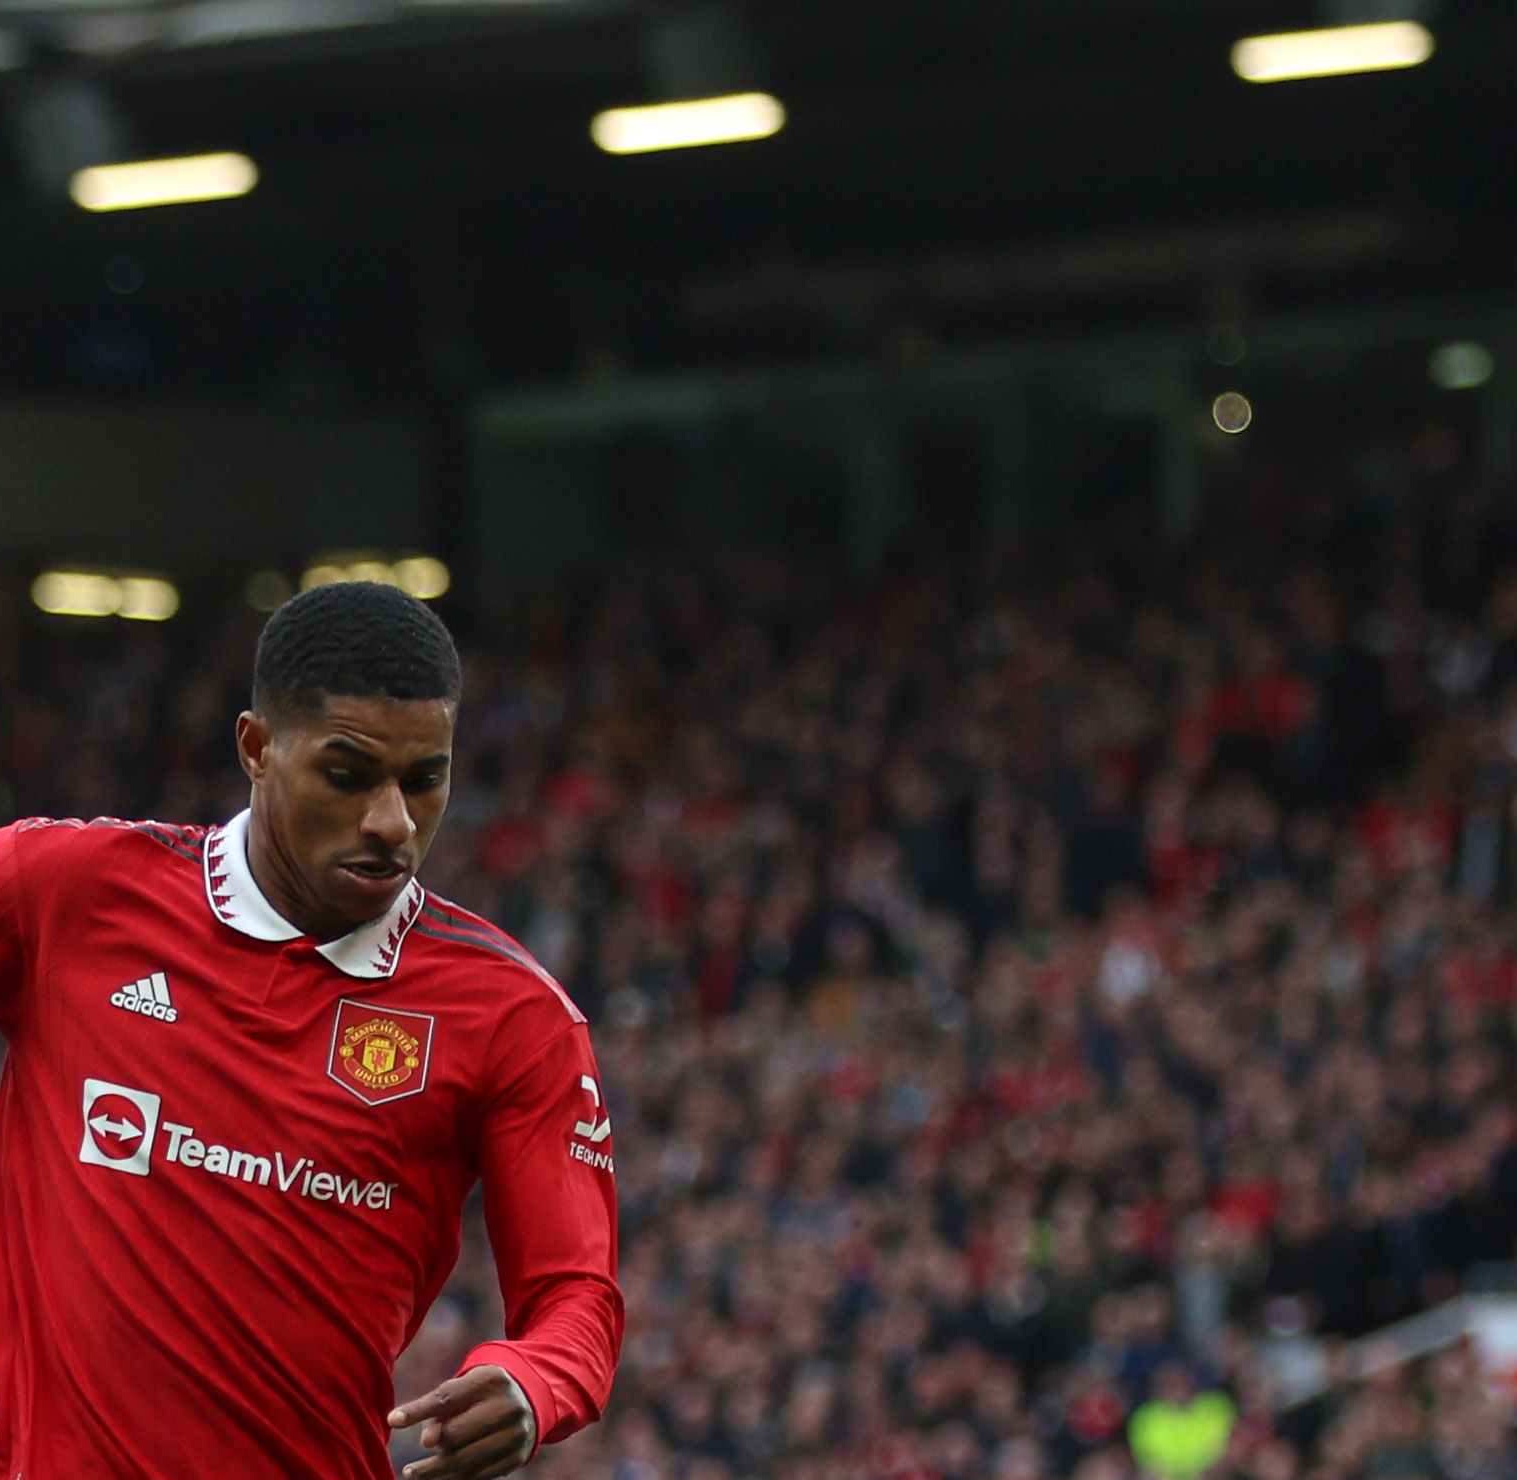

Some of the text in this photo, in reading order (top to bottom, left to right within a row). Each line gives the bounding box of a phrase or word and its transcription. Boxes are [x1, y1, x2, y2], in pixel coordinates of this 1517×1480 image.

[110, 990, 178, 1023] adidas
[350, 1023, 413, 1051] MANCHESTER
[353, 1068, 400, 1084] UNITED
[162, 1121, 399, 1210] TeamViewer
